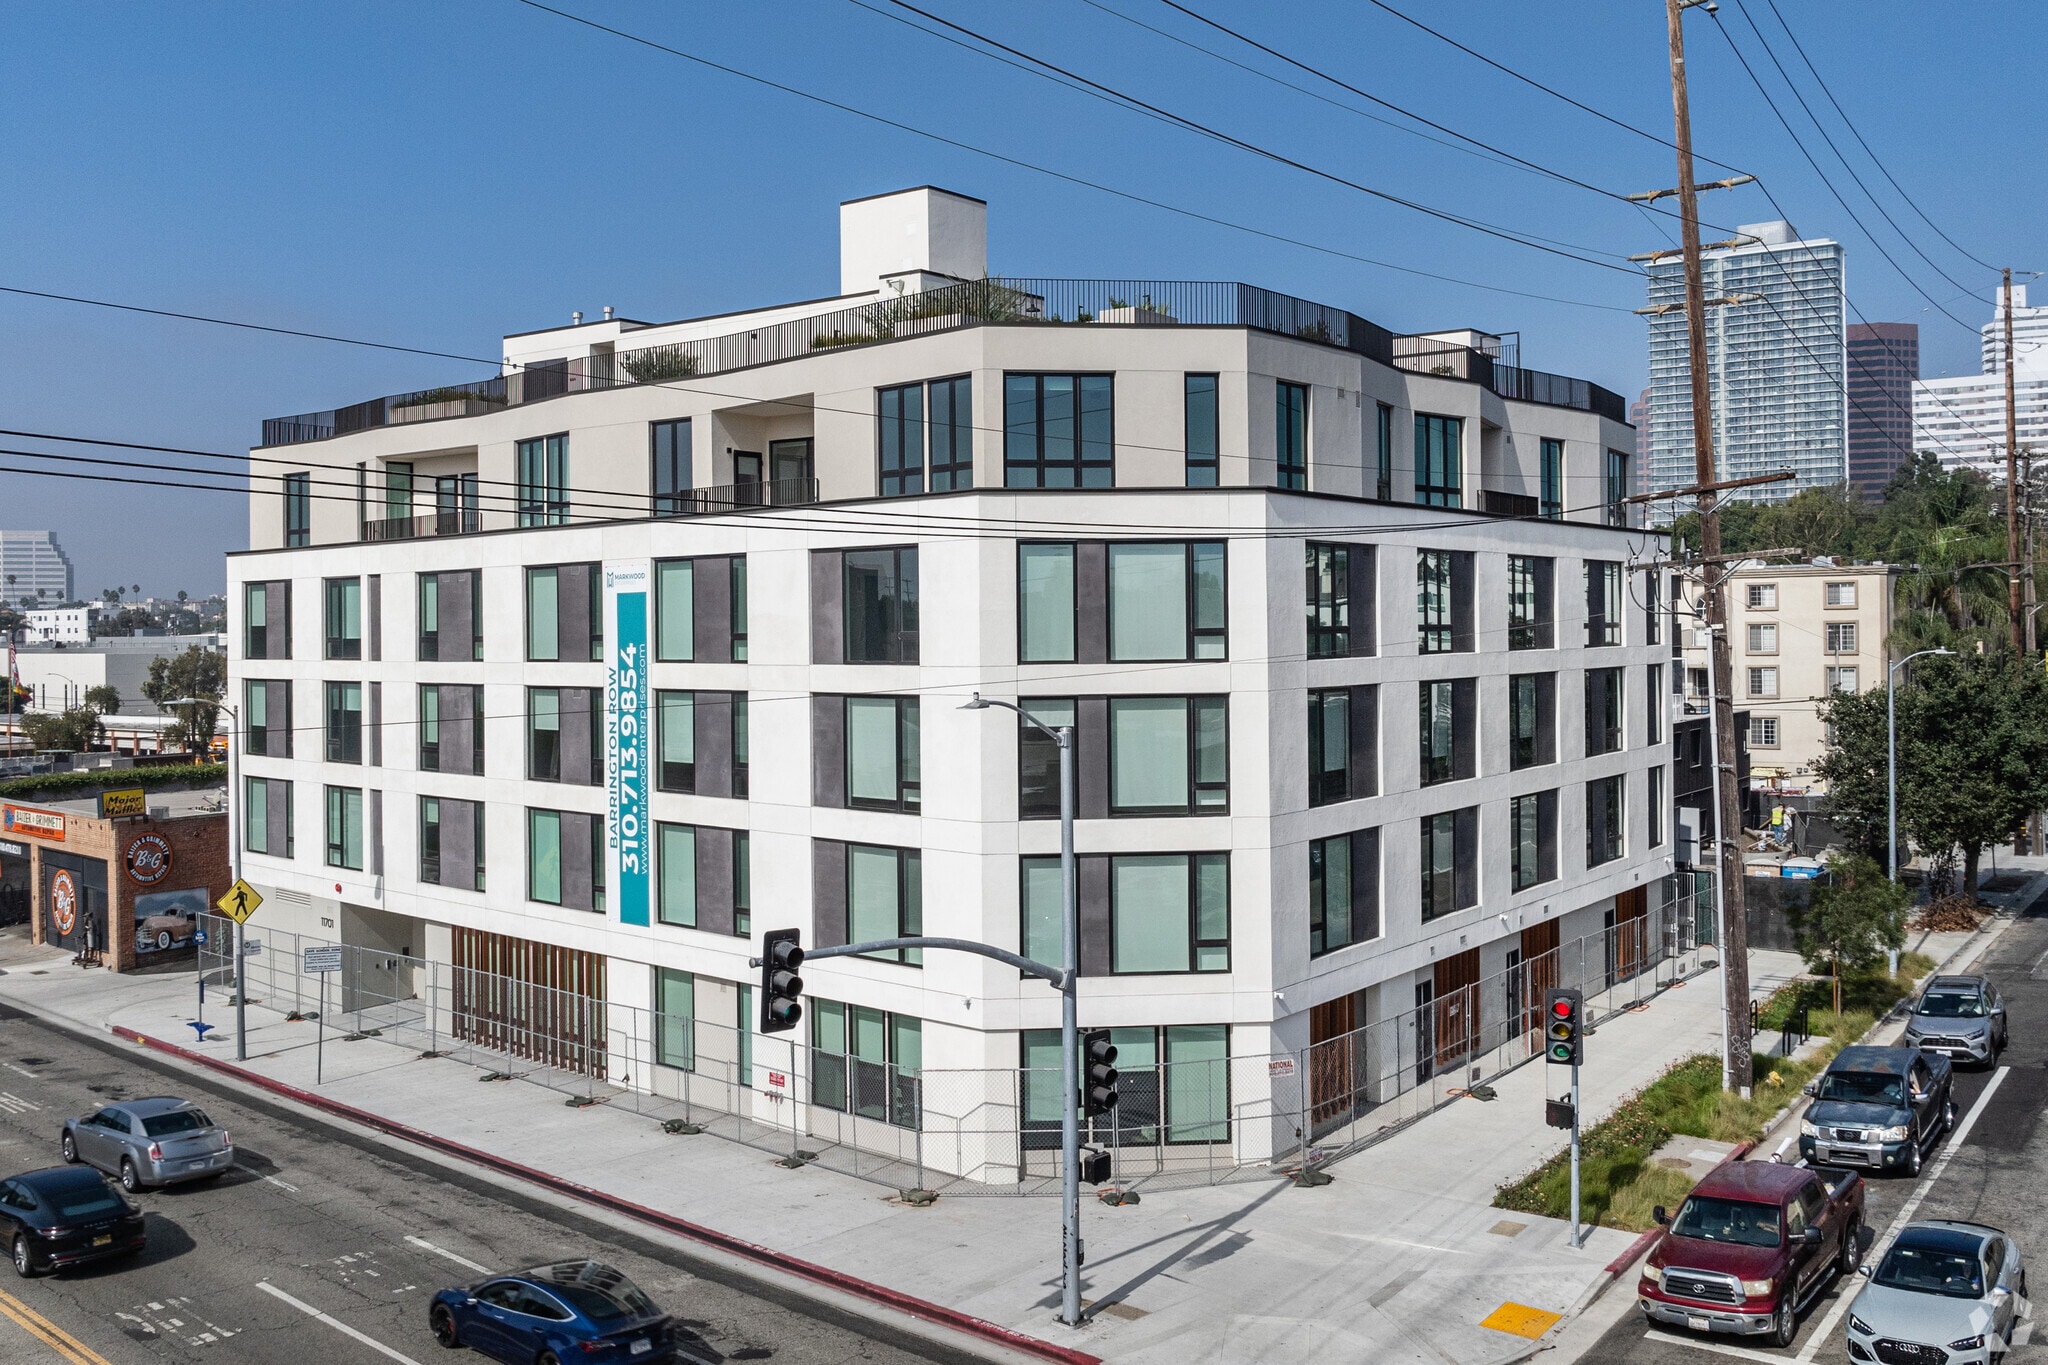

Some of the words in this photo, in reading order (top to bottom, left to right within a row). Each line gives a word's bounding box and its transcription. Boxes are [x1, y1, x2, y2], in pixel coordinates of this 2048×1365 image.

[614, 572, 646, 581] MARKWOOD
[608, 667, 618, 715] ROW
[620, 643, 639, 875] 310.713.9854
[638, 643, 649, 875] www.markwoodenterprises.com
[608, 724, 618, 849] BARRINGTON
[108, 795, 142, 805] Major
[105, 805, 143, 815] Muffler
[135, 850, 162, 869] B&G
[1269, 1060, 1293, 1069] NATIONAL
